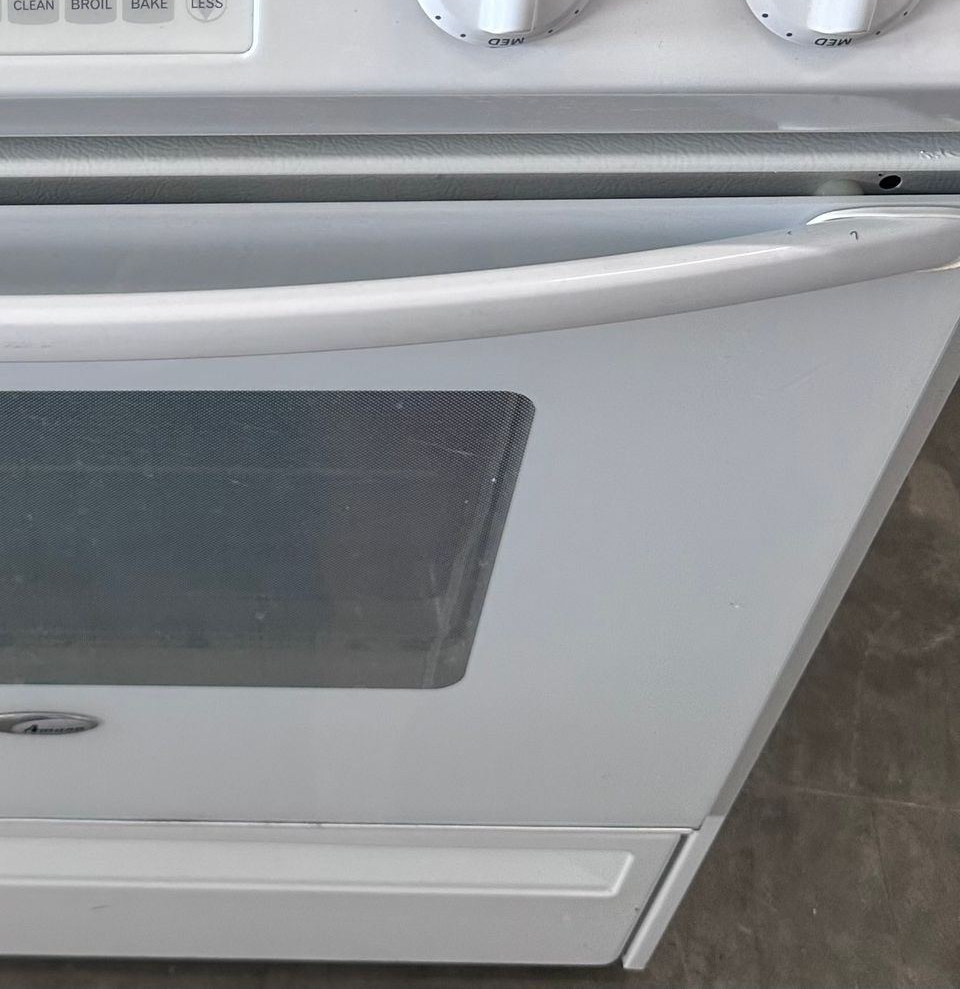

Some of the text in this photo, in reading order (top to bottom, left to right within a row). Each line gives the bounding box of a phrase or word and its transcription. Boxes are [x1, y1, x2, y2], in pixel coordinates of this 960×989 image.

[13, 0, 55, 11] CLEAN
[488, 36, 526, 47] MED
[814, 37, 853, 47] MED
